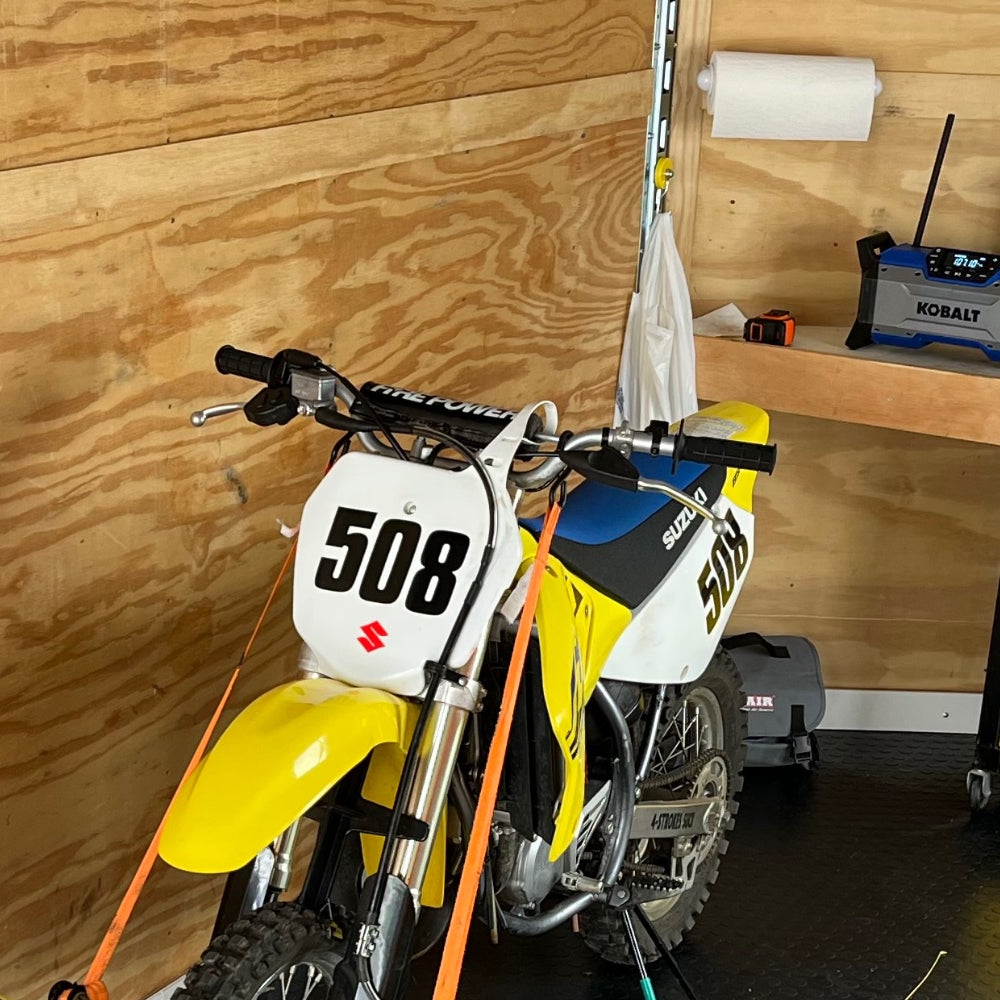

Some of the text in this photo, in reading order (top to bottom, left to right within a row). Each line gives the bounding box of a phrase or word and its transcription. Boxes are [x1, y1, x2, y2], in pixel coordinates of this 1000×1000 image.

[917, 301, 981, 323] KOBALT
[314, 506, 470, 616] 508
[697, 508, 748, 635] 508
